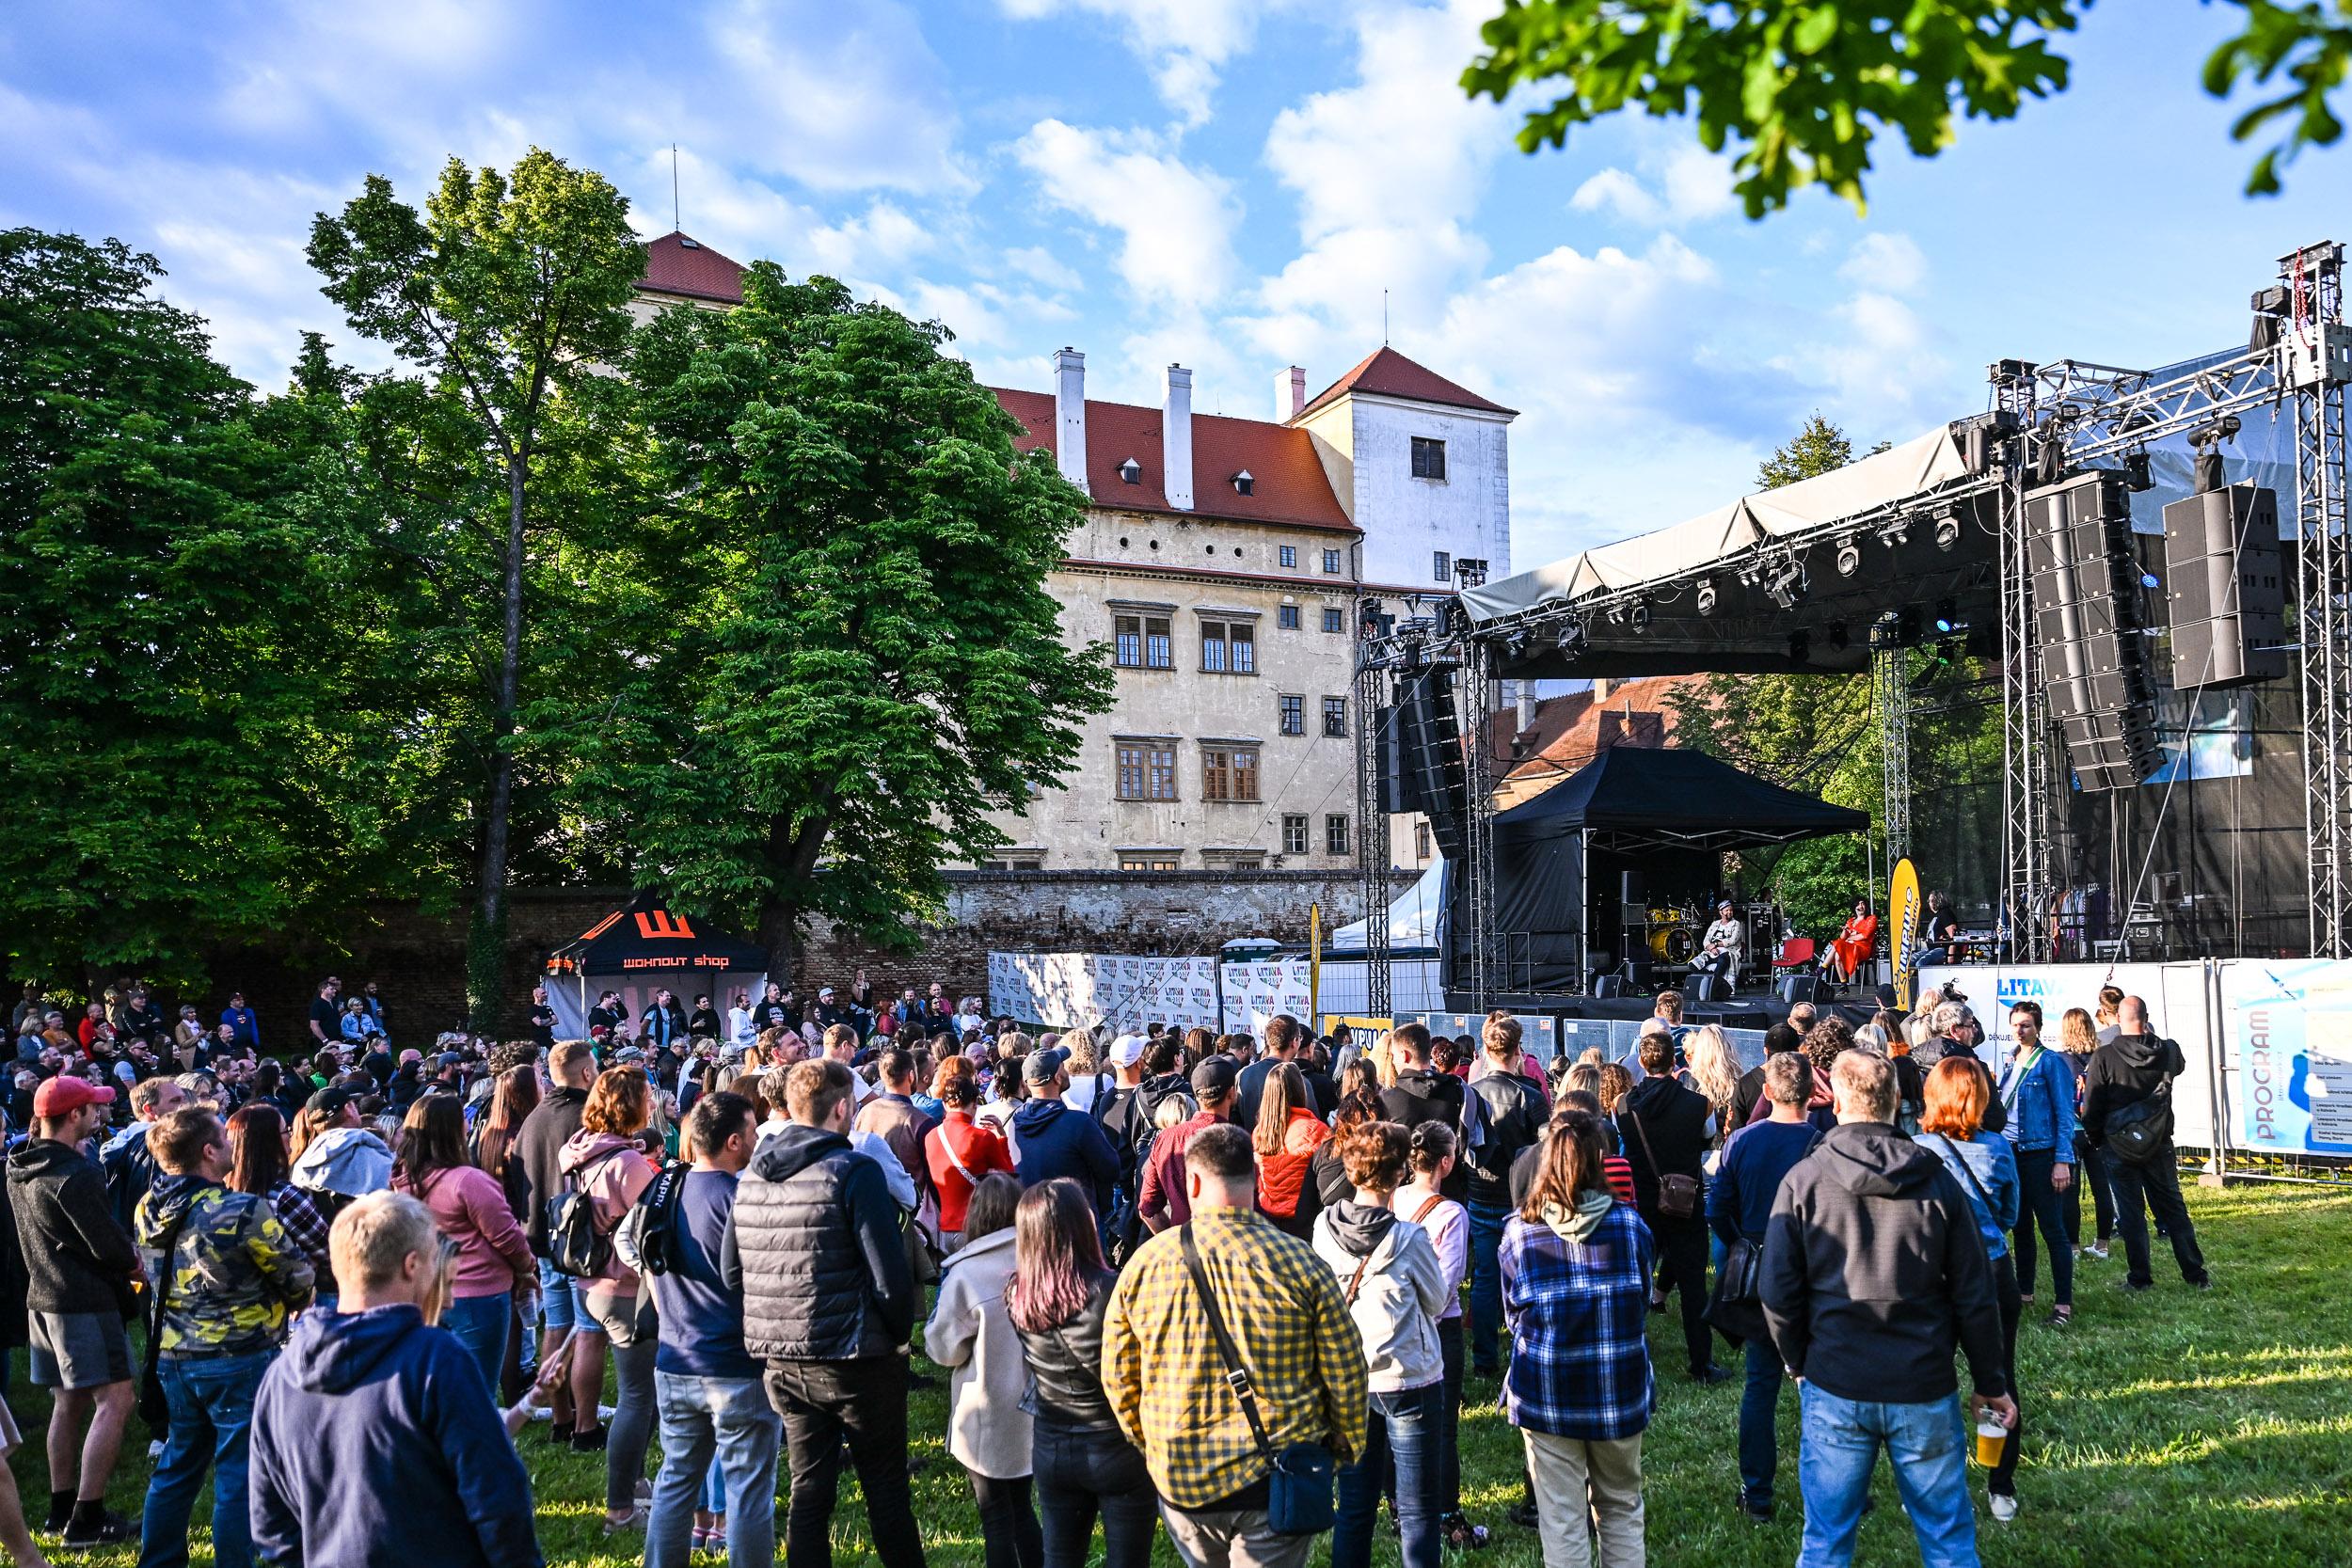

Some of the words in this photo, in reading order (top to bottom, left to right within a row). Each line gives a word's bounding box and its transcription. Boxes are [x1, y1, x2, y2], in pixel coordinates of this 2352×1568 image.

[694, 954, 729, 970] shop
[1997, 978, 2058, 996] LITAV
[2249, 1010, 2276, 1140] PROGRAM
